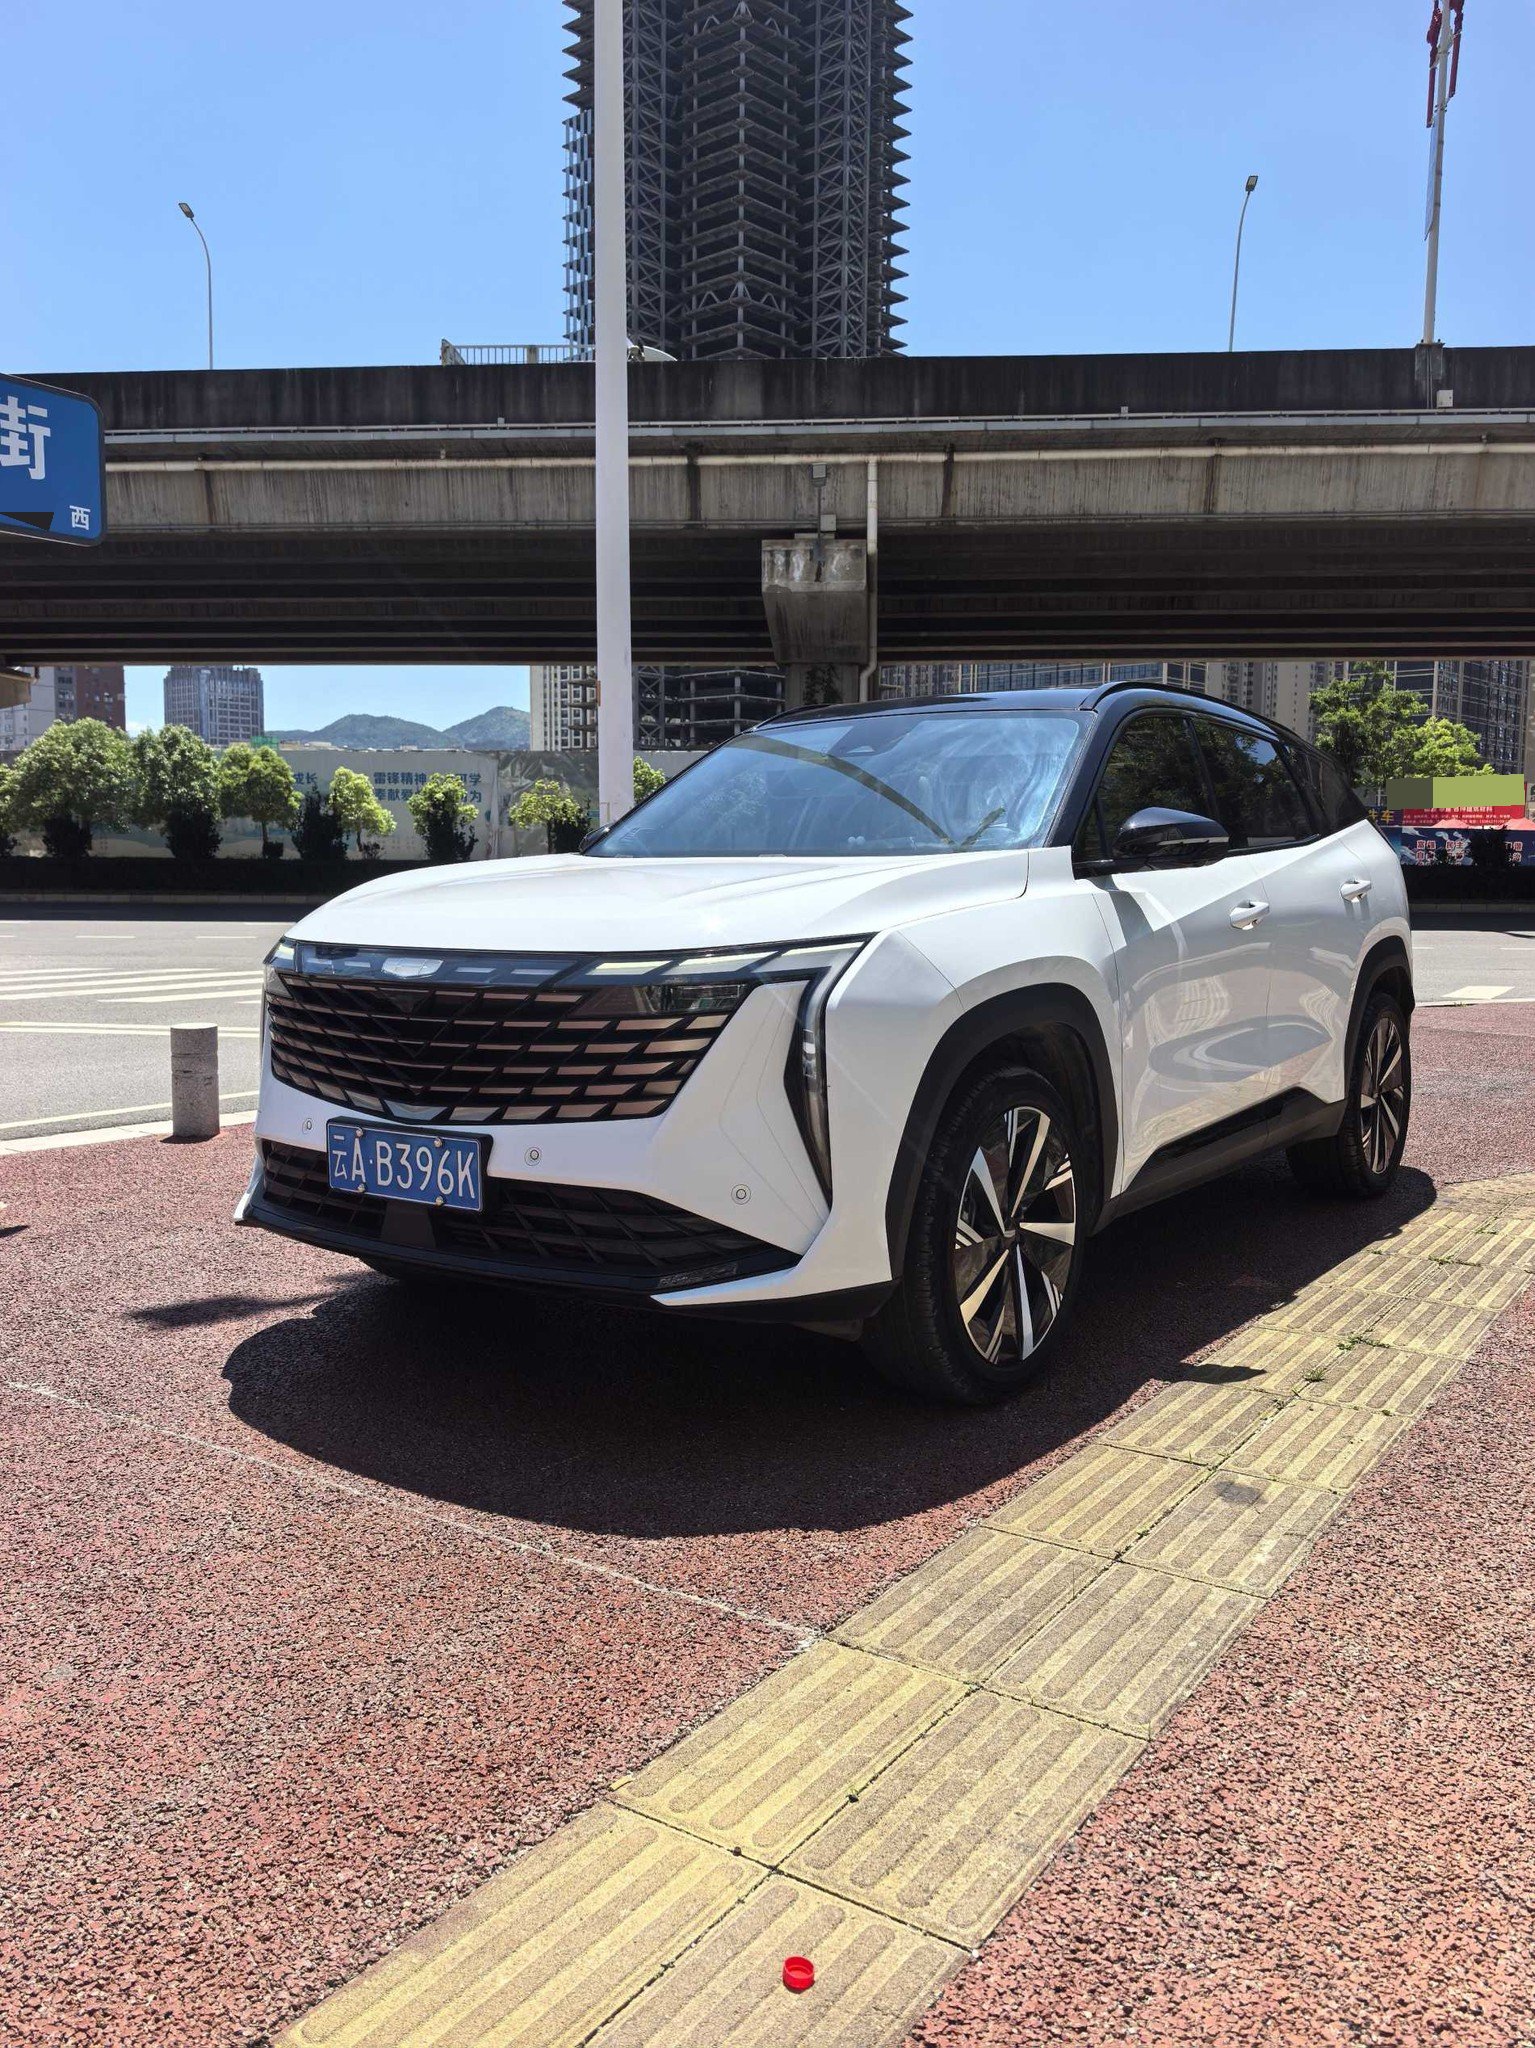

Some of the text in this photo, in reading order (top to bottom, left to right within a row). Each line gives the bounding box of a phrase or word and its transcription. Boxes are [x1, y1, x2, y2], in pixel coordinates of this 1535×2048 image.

[69, 505, 91, 531] 西
[373, 772, 426, 785] 雷锋精神
